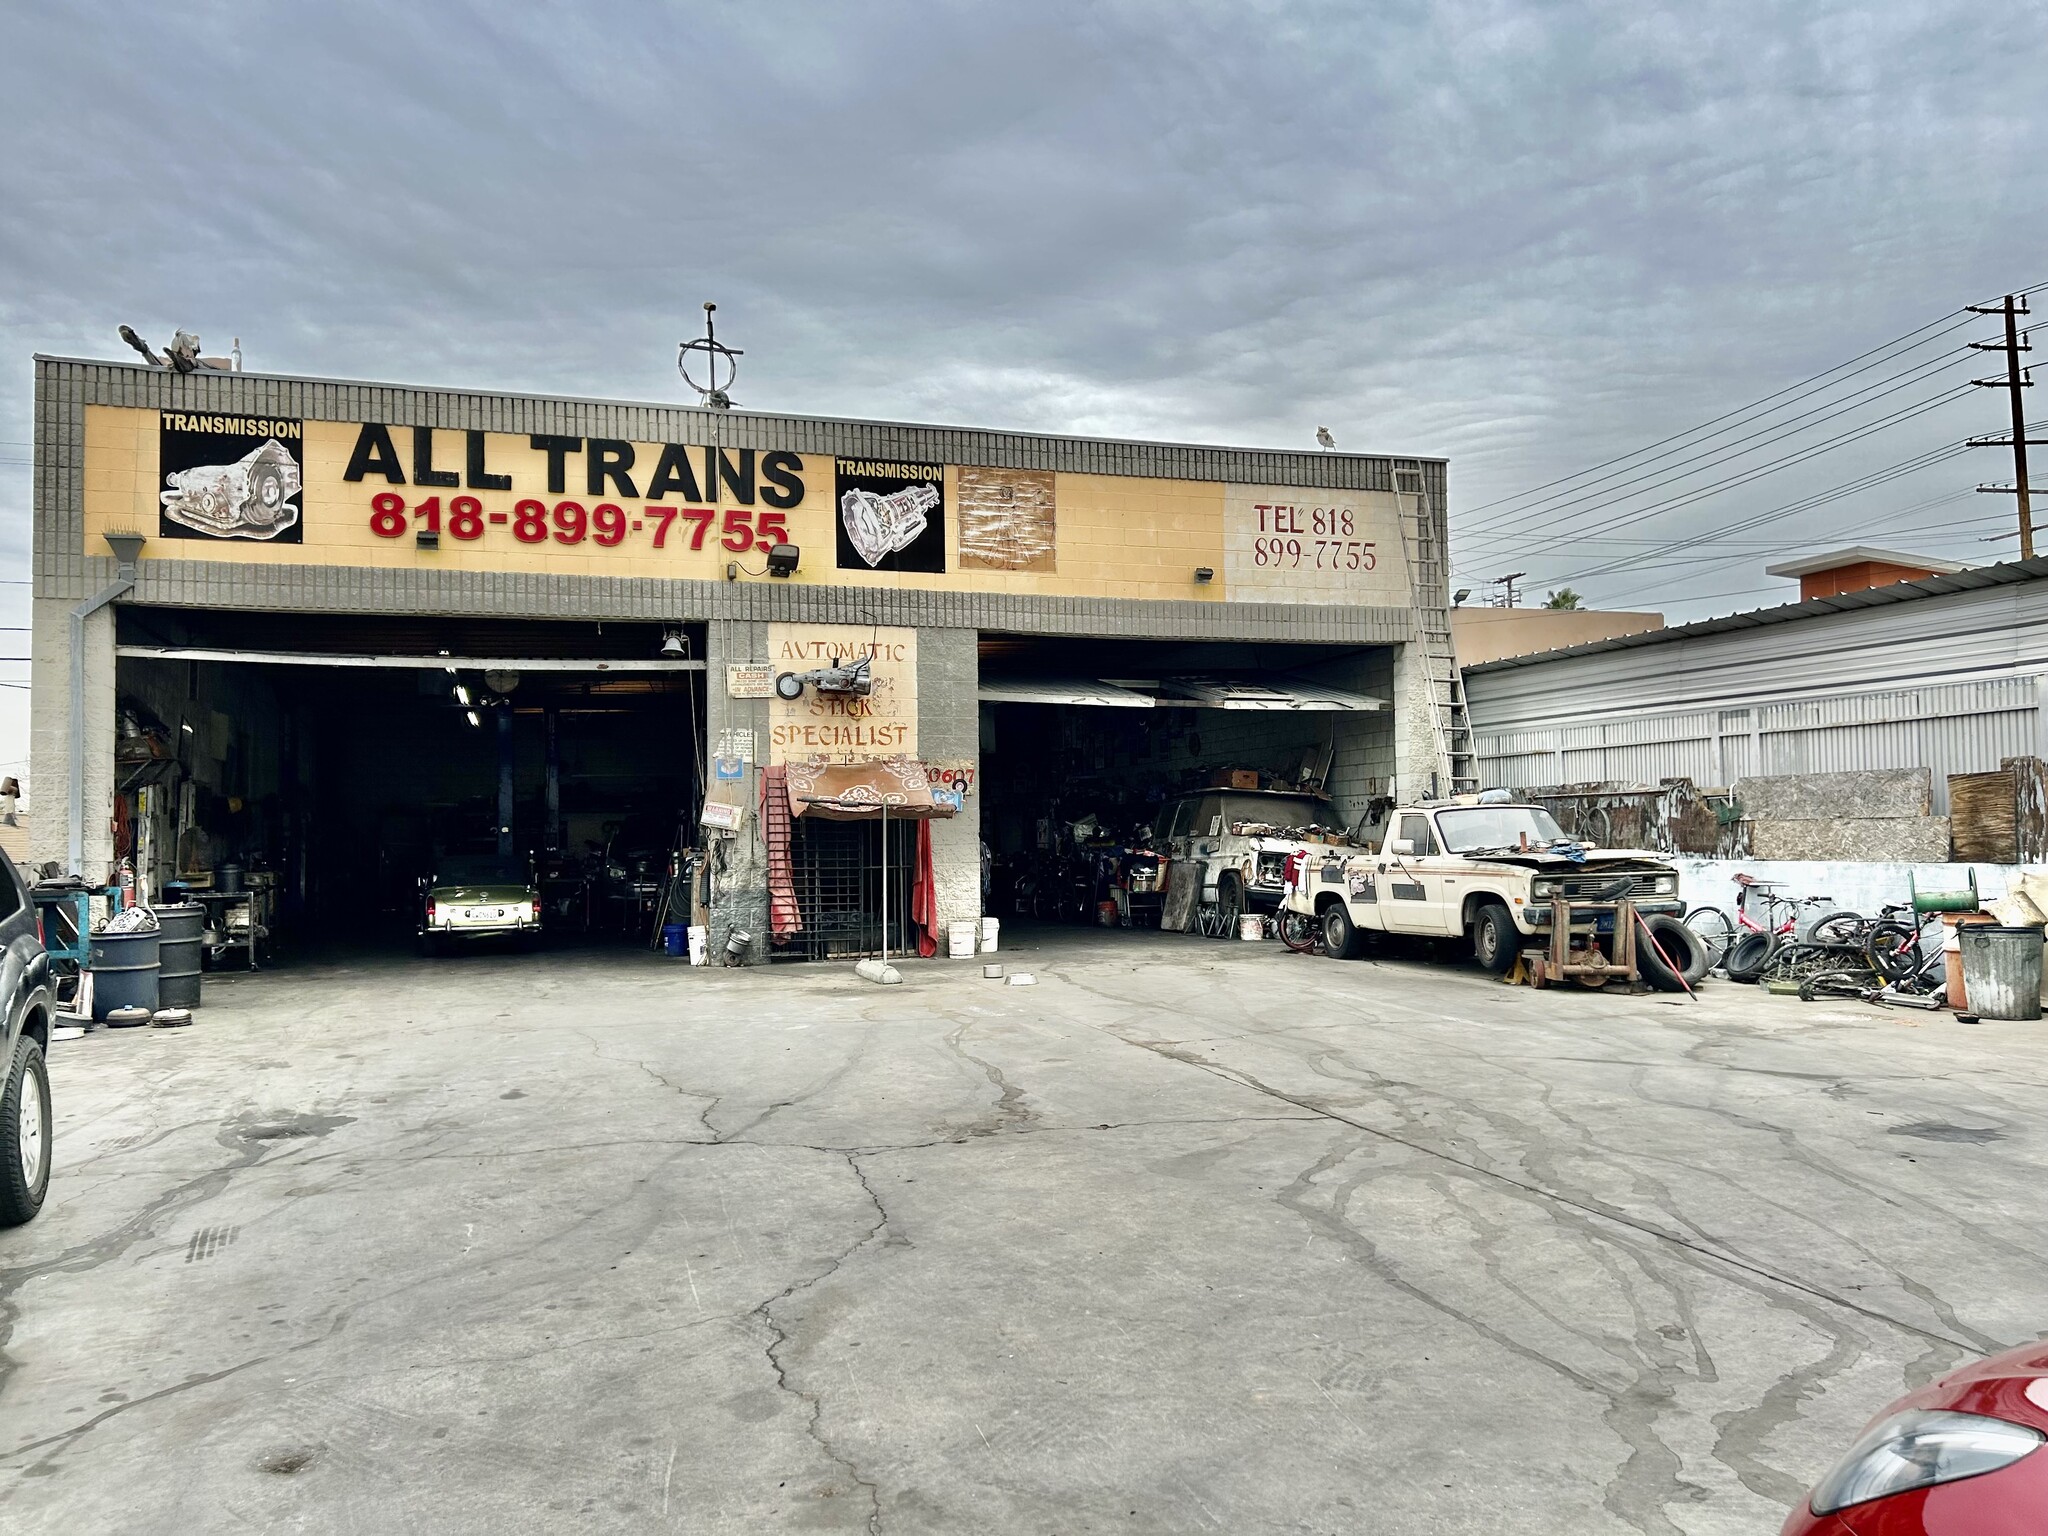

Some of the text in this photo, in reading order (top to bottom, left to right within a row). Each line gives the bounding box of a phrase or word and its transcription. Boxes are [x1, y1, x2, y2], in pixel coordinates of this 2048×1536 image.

[162, 413, 300, 439] TRANSMISSION
[343, 422, 804, 509] ALL TRANS
[837, 459, 943, 482] TRANSMISSION
[369, 492, 789, 554] 818-899-7755
[1312, 507, 1354, 537] 818
[1254, 537, 1377, 571] 899-7755
[809, 698, 873, 717] STICK
[772, 725, 908, 746] SPECIALIST
